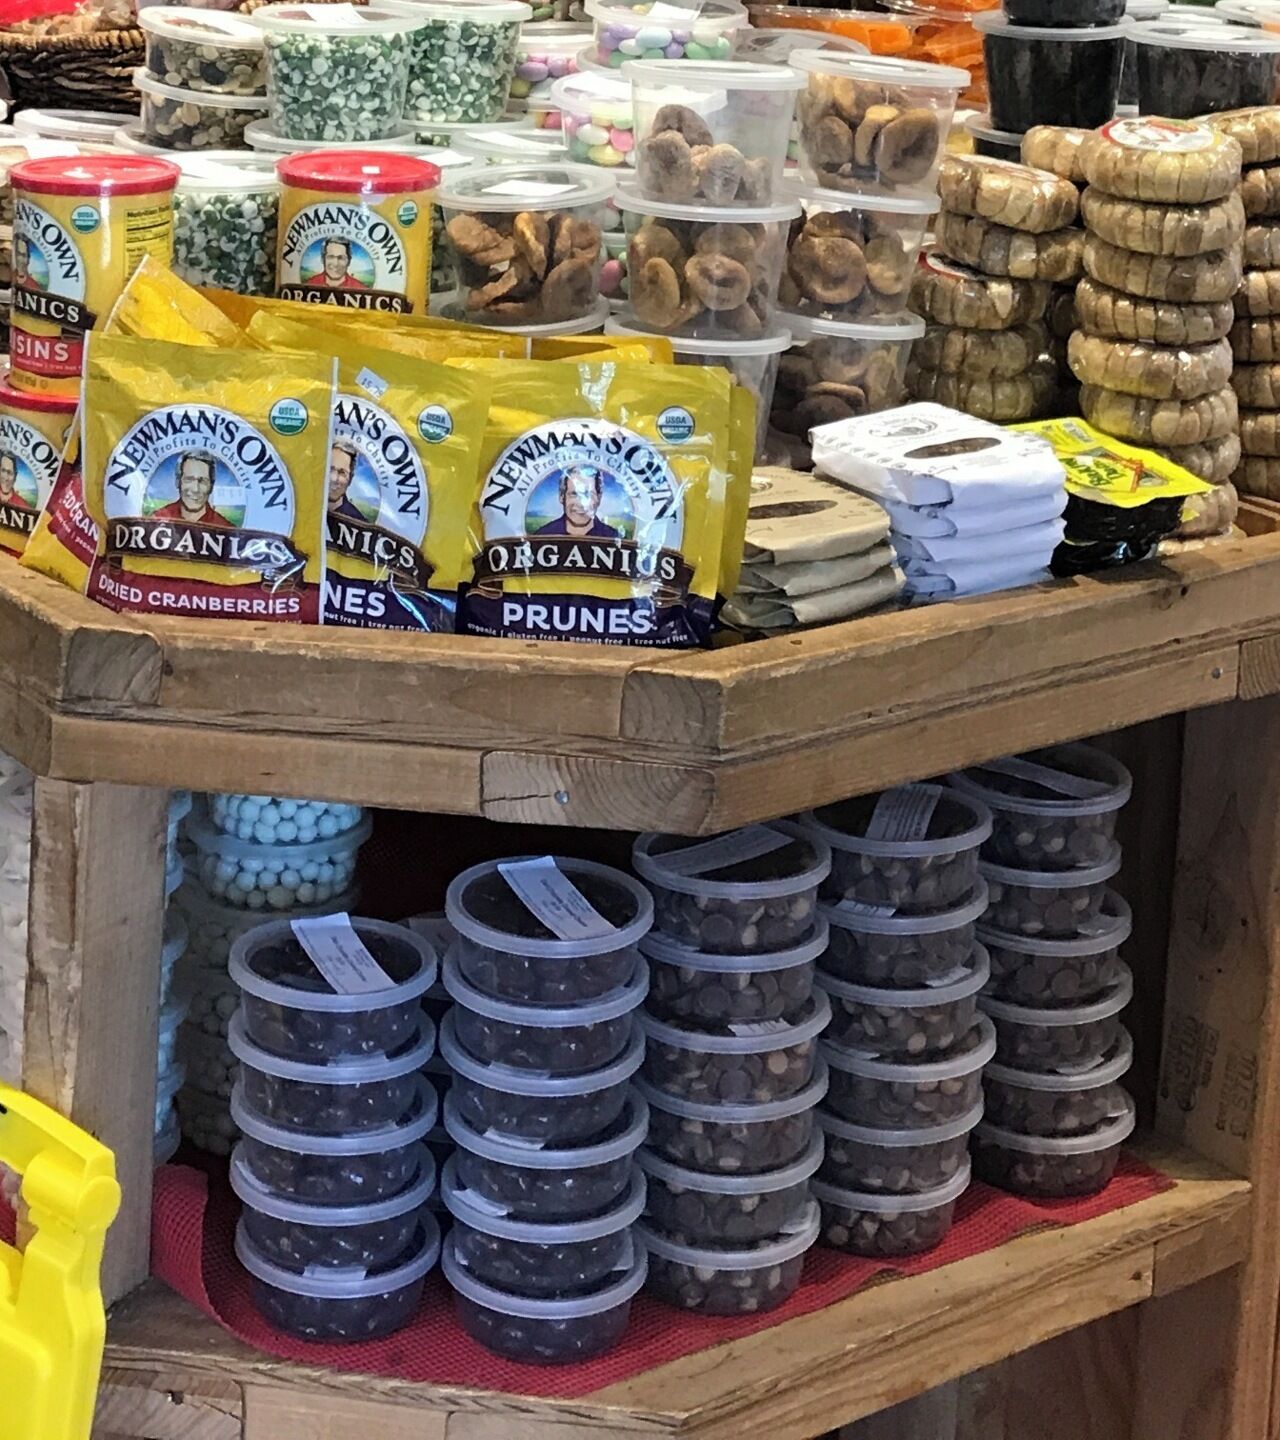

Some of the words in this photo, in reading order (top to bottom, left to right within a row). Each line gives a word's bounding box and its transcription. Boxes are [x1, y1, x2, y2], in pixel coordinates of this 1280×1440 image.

[41, 223, 79, 282] OWN
[282, 206, 367, 268] NEWMAN'S
[366, 217, 404, 277] OWN
[16, 293, 80, 324] ANICS
[281, 284, 403, 314] ORGANICS
[15, 334, 70, 362] SINS
[278, 406, 300, 417] USDA
[665, 415, 687, 425] USDA
[108, 409, 240, 496] NEWMAN'S
[235, 435, 288, 512] OWN
[154, 436, 198, 462] Profits
[200, 436, 217, 451] To
[219, 442, 253, 492] Charity
[334, 401, 386, 443] AN'S
[381, 435, 421, 518] OWN
[347, 430, 364, 445] To
[365, 437, 389, 490] Charity
[586, 450, 602, 462] To
[115, 522, 288, 566] ORGANICS
[327, 520, 417, 570] ANICS
[489, 544, 676, 581] ORGANICS
[99, 573, 141, 603] DRIED
[148, 589, 300, 615] CRANBERRIES
[326, 580, 387, 618] NES
[503, 602, 653, 635] PRUNES
